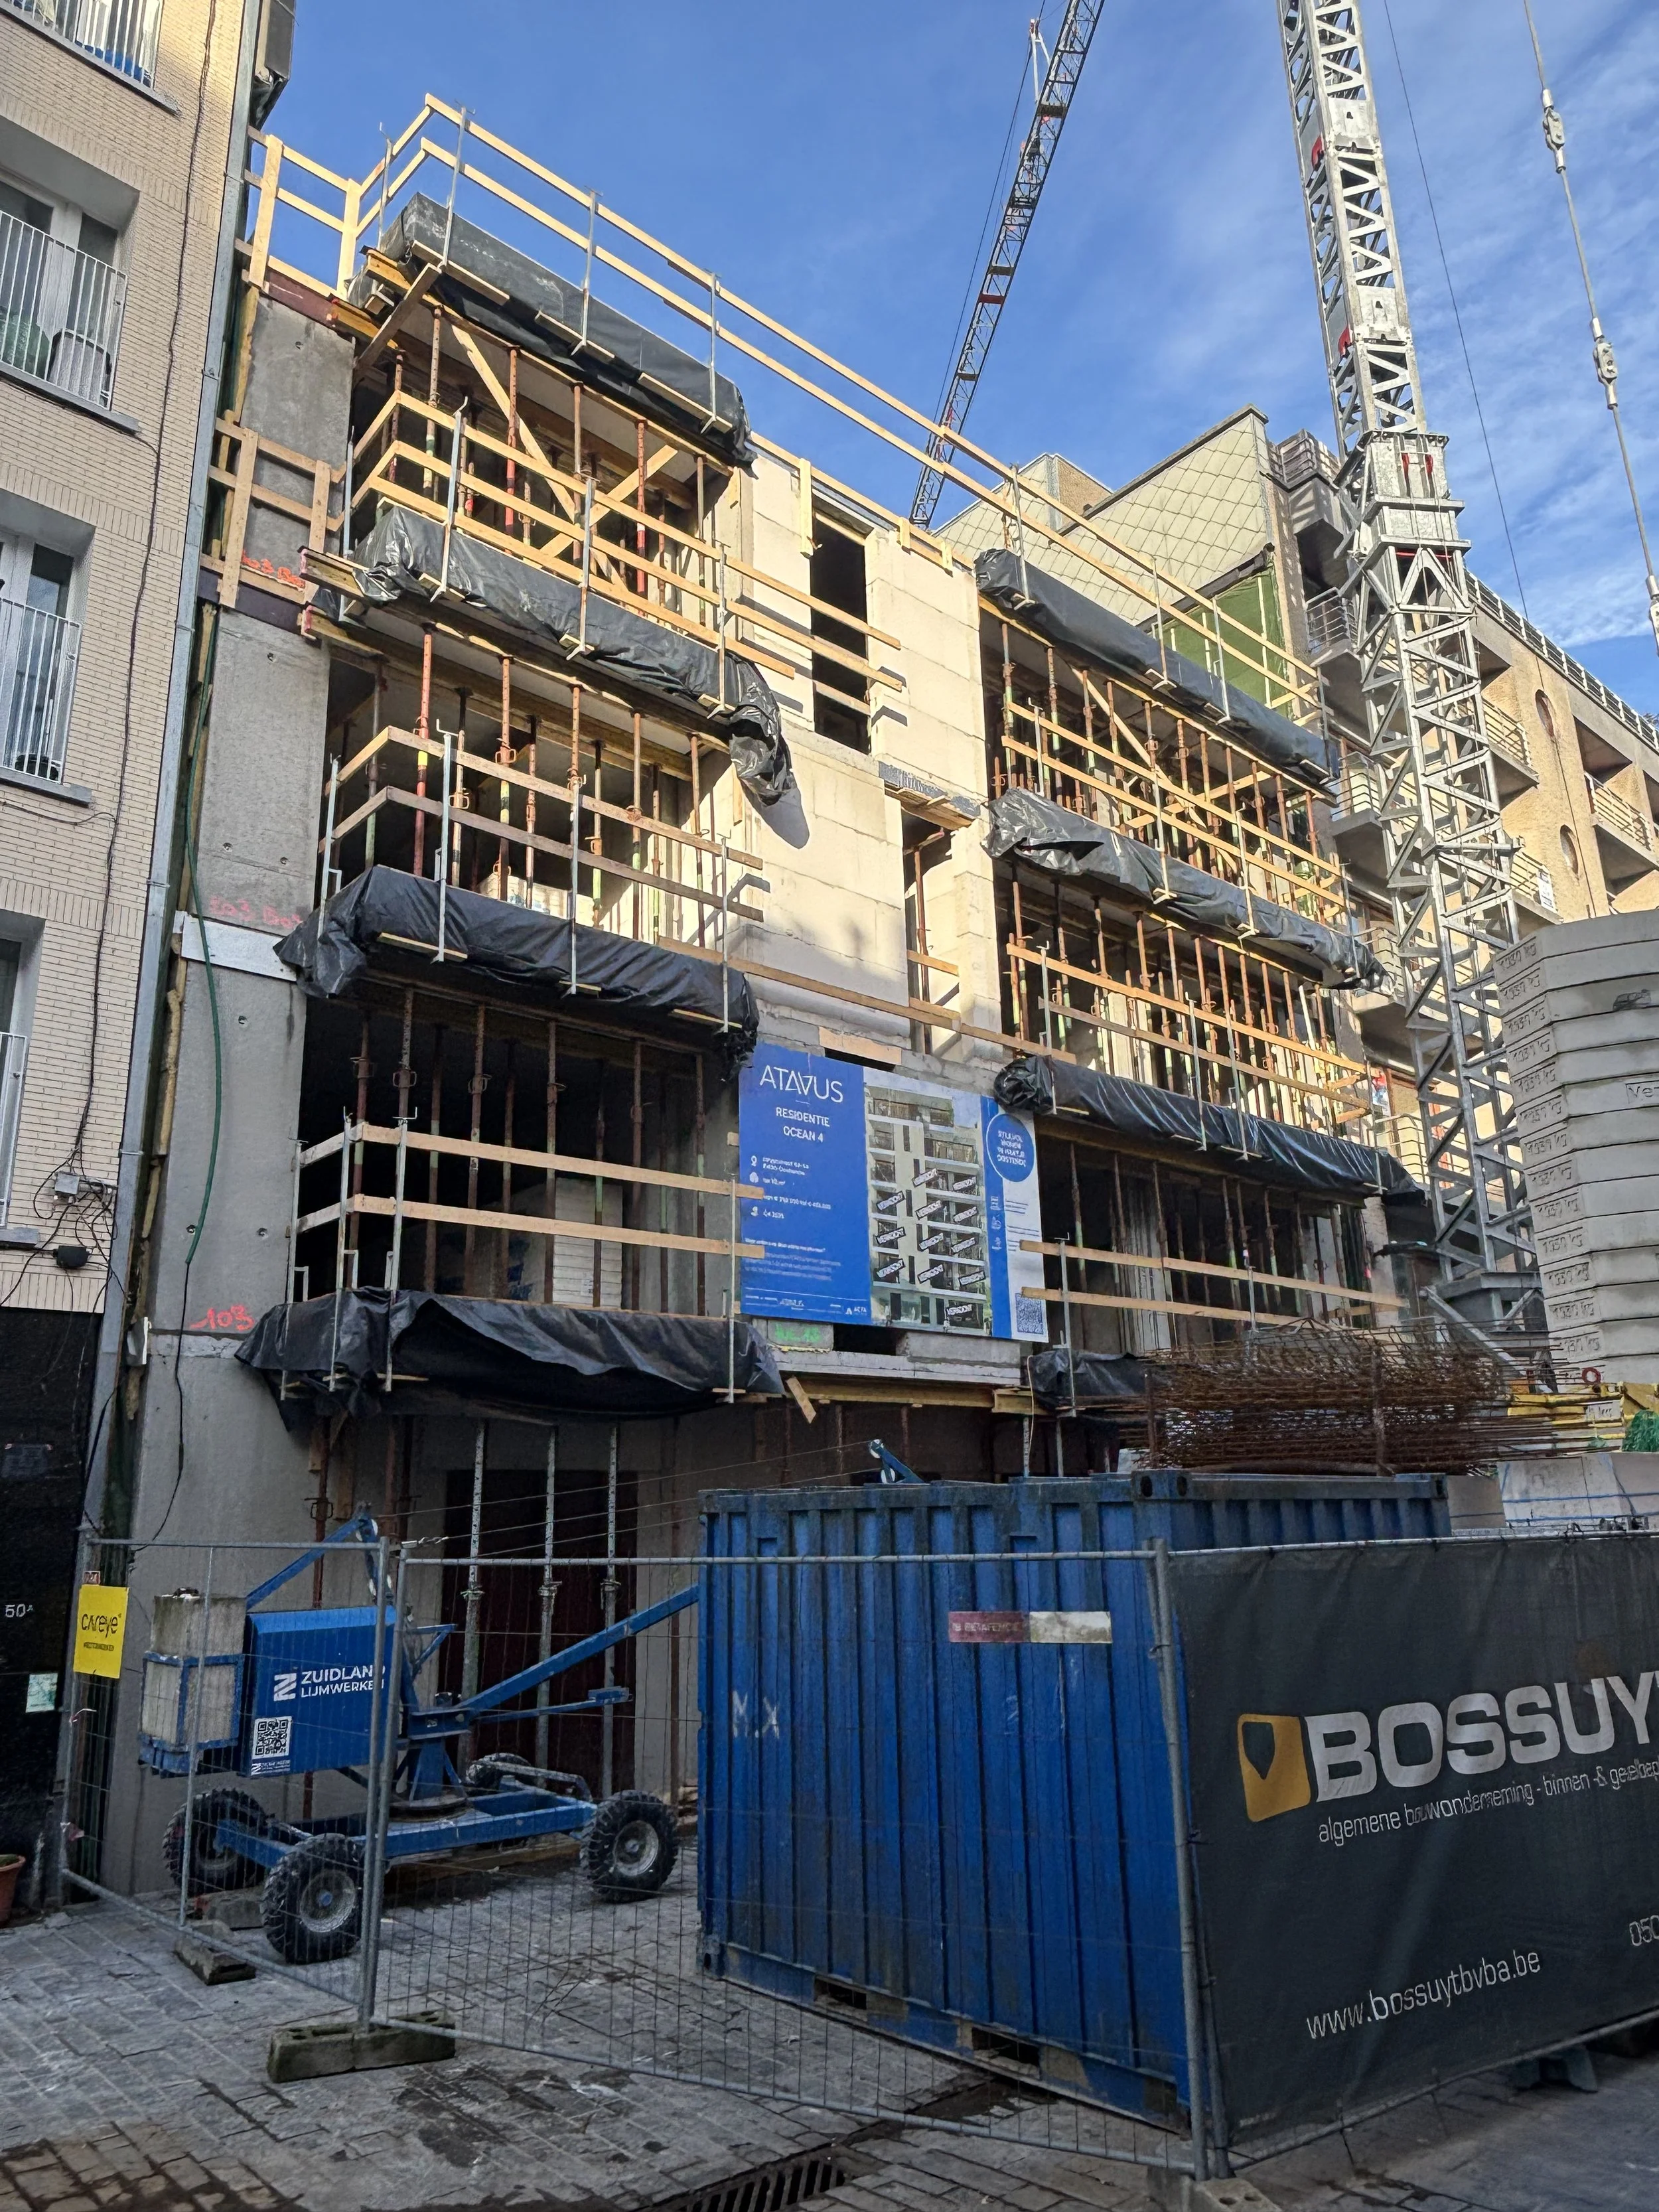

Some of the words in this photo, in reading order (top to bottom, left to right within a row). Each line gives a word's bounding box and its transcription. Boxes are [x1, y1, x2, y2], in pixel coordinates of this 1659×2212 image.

[759, 1065, 843, 1103] ATAVUS
[776, 1106, 830, 1127] RESIDENTIE
[783, 1126, 816, 1141] OCEAN
[818, 1132, 824, 1143] 4
[301, 1664, 385, 1684] ZUIDLAN
[301, 1680, 384, 1698] LIJMWERKE
[1304, 1670, 1659, 1803] BOSSUY
[1318, 1816, 1402, 1847] algemene
[1542, 1773, 1591, 1796] binnen
[1593, 1765, 1608, 1787] &
[1306, 1949, 1542, 2039] www.bossuytbvba.be
